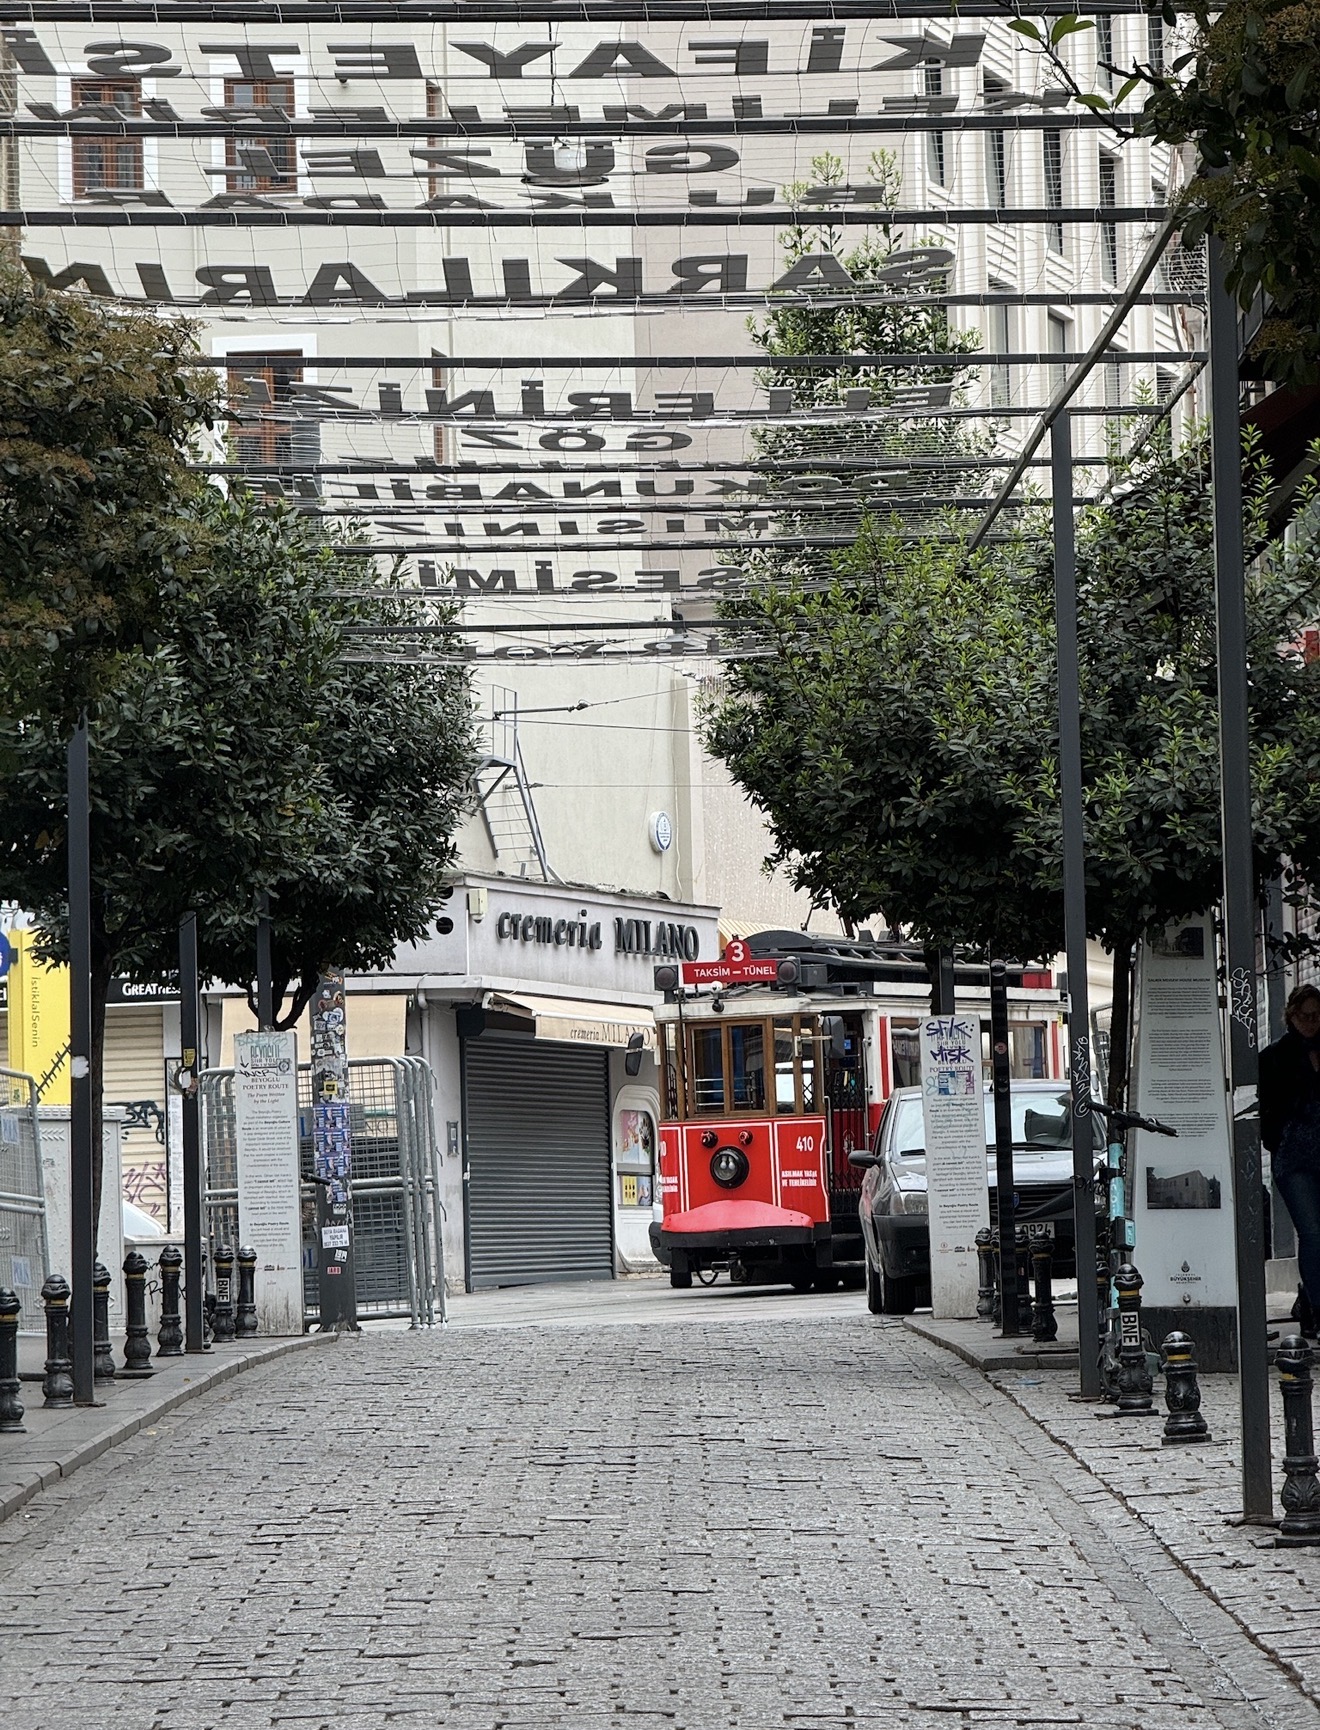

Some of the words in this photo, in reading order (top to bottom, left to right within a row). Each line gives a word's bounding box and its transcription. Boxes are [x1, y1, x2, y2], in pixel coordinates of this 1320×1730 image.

[498, 909, 602, 950] cremeria
[615, 917, 700, 962] MILANO
[730, 941, 745, 962] 3
[694, 966, 731, 978] TAKSİM
[743, 965, 776, 976] TÜNEL
[570, 1027, 600, 1042] cremeria
[796, 1135, 814, 1152] 410
[218, 1278, 229, 1302] BNE
[1122, 1313, 1138, 1345] BNE
